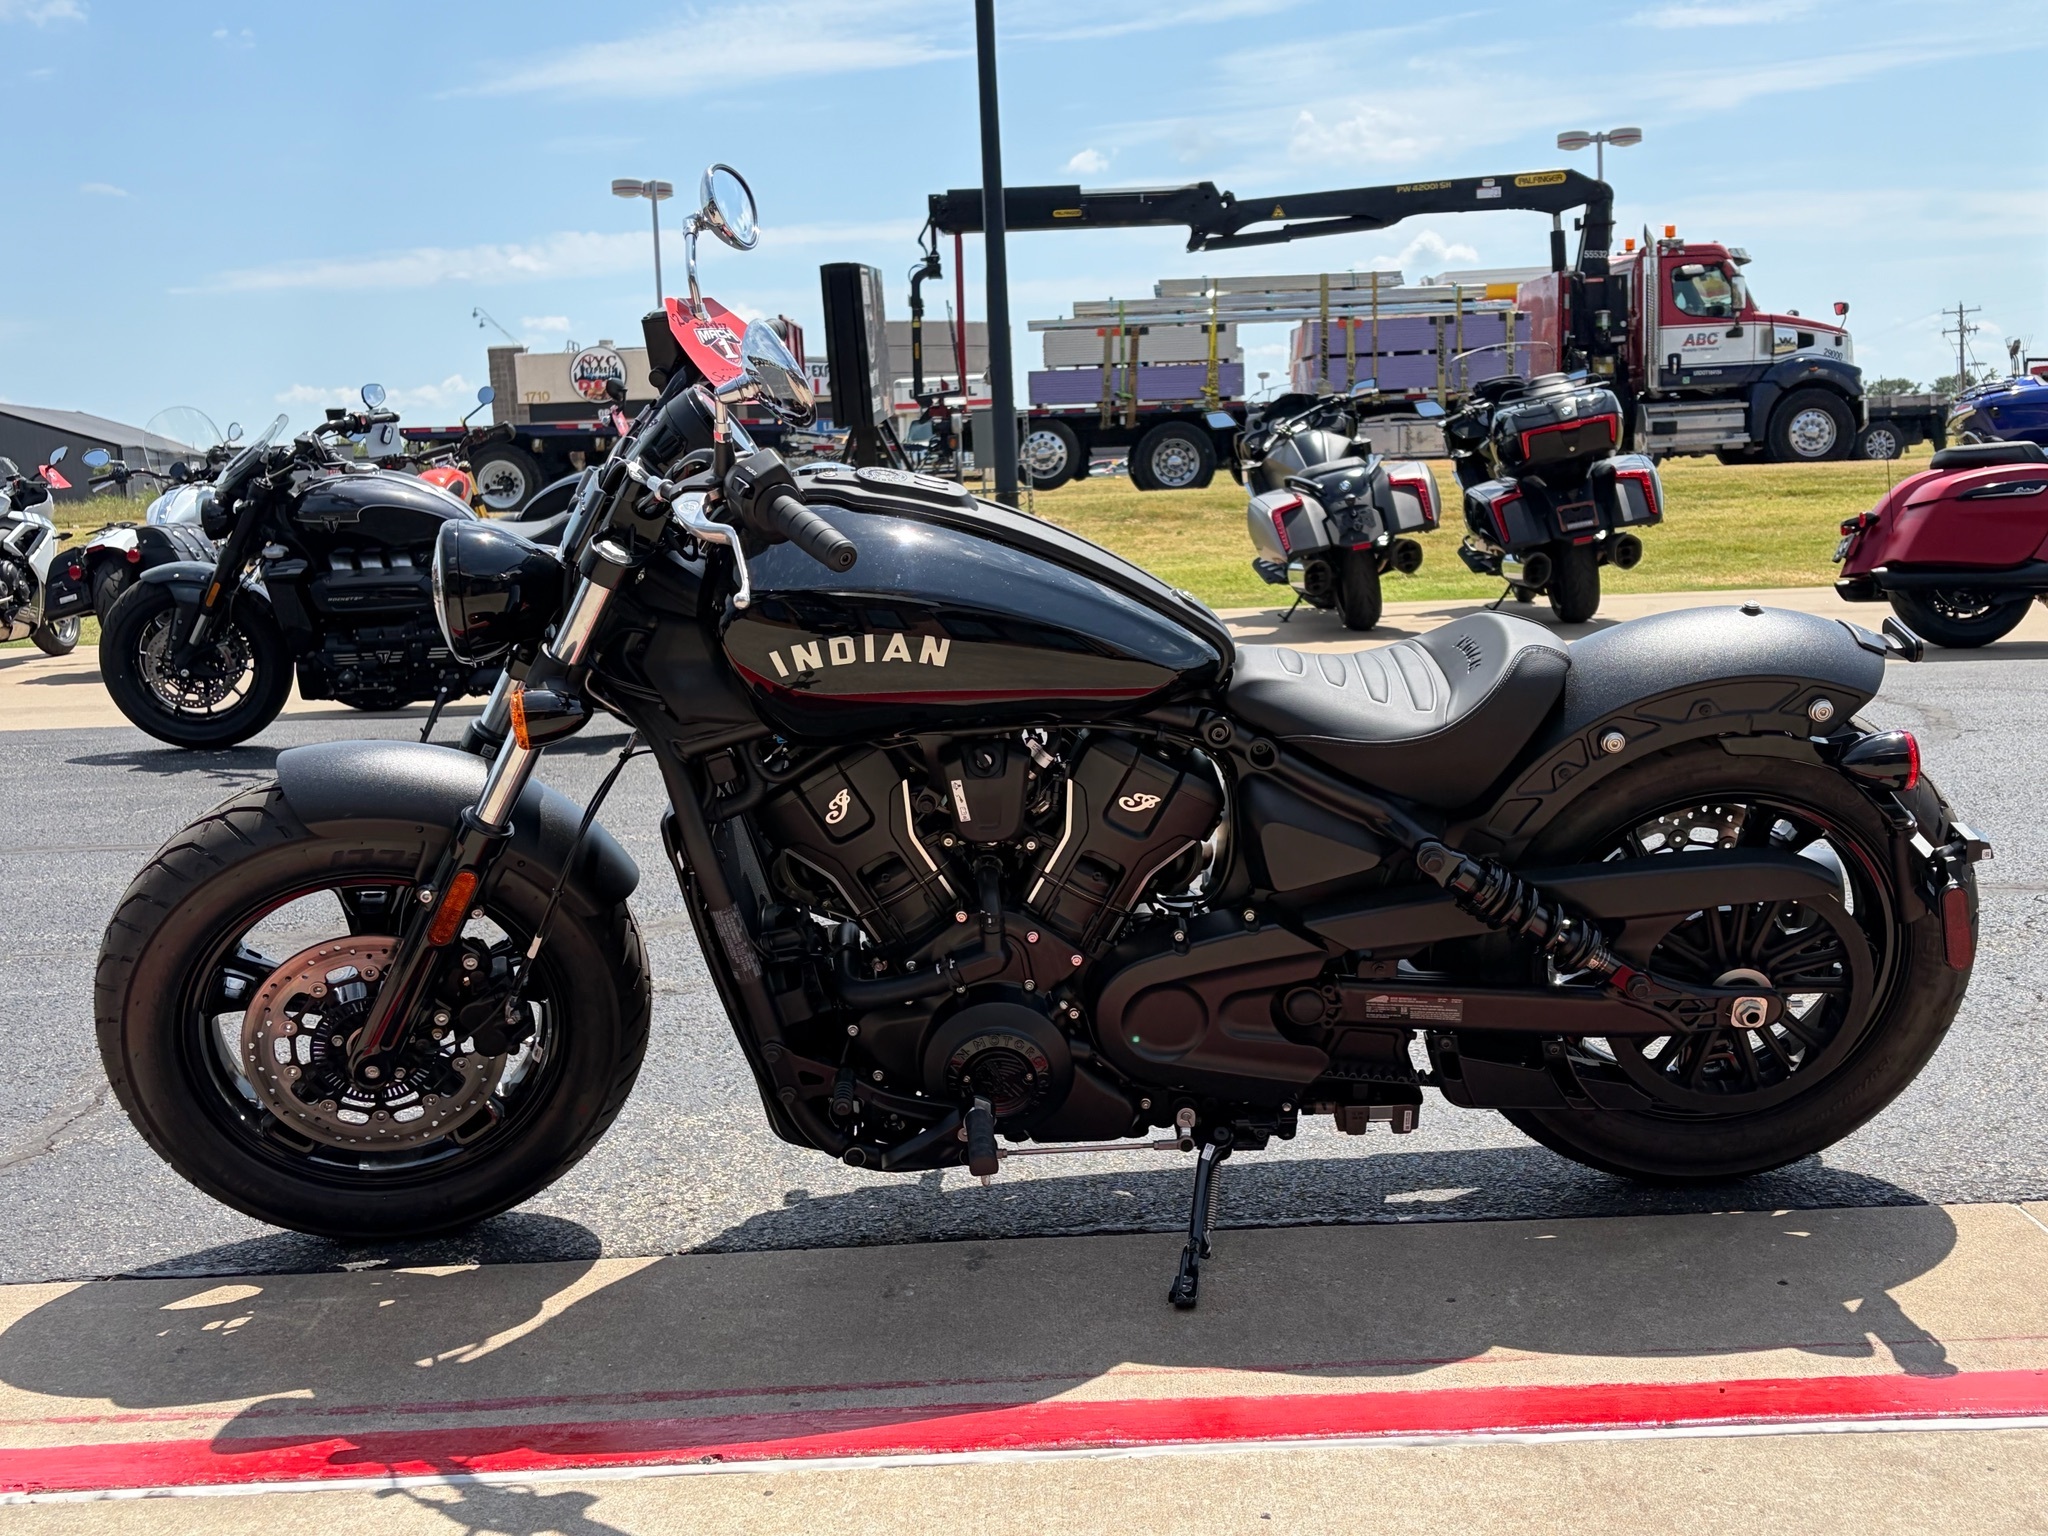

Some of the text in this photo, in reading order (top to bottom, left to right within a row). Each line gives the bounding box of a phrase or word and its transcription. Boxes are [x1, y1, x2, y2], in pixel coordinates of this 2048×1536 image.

[1517, 174, 1564, 185] PALFINGER
[1583, 249, 1608, 259] 55532
[697, 327, 736, 344] MACH
[1682, 332, 1719, 347] ABC
[719, 338, 739, 359] 1
[1824, 347, 1844, 361] 29000
[524, 391, 551, 403] 1710
[769, 632, 951, 678] INDIAN
